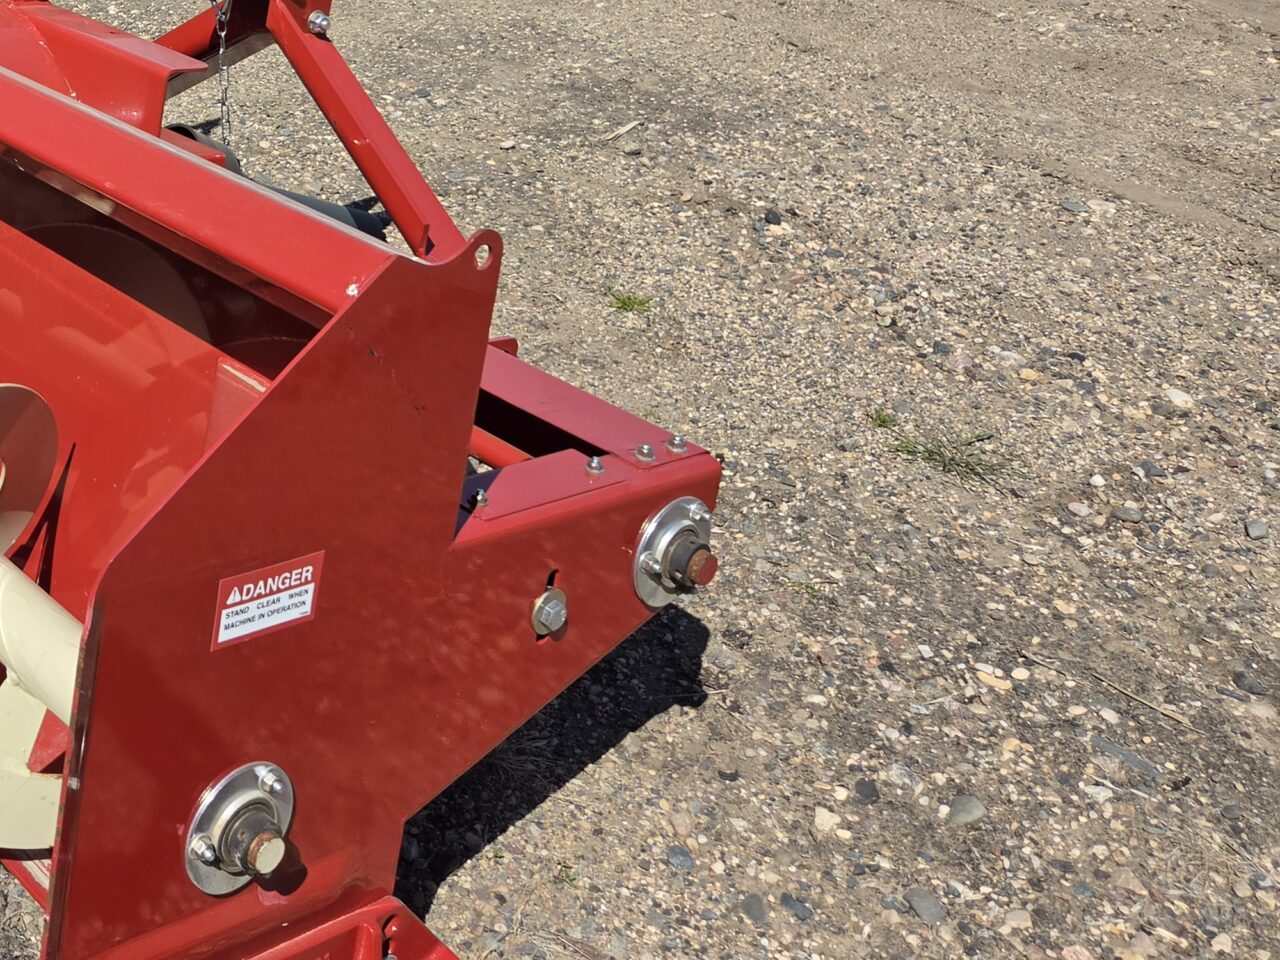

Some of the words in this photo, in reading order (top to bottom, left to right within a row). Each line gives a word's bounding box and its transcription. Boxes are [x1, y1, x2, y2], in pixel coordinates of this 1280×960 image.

[242, 565, 313, 601] DANGER
[224, 615, 257, 630] MACHINE
[258, 612, 266, 620] IN
[267, 600, 307, 617] OPERATION
[225, 606, 250, 619] STAND
[256, 597, 281, 610] CLEAR
[288, 589, 309, 600] WHEN
